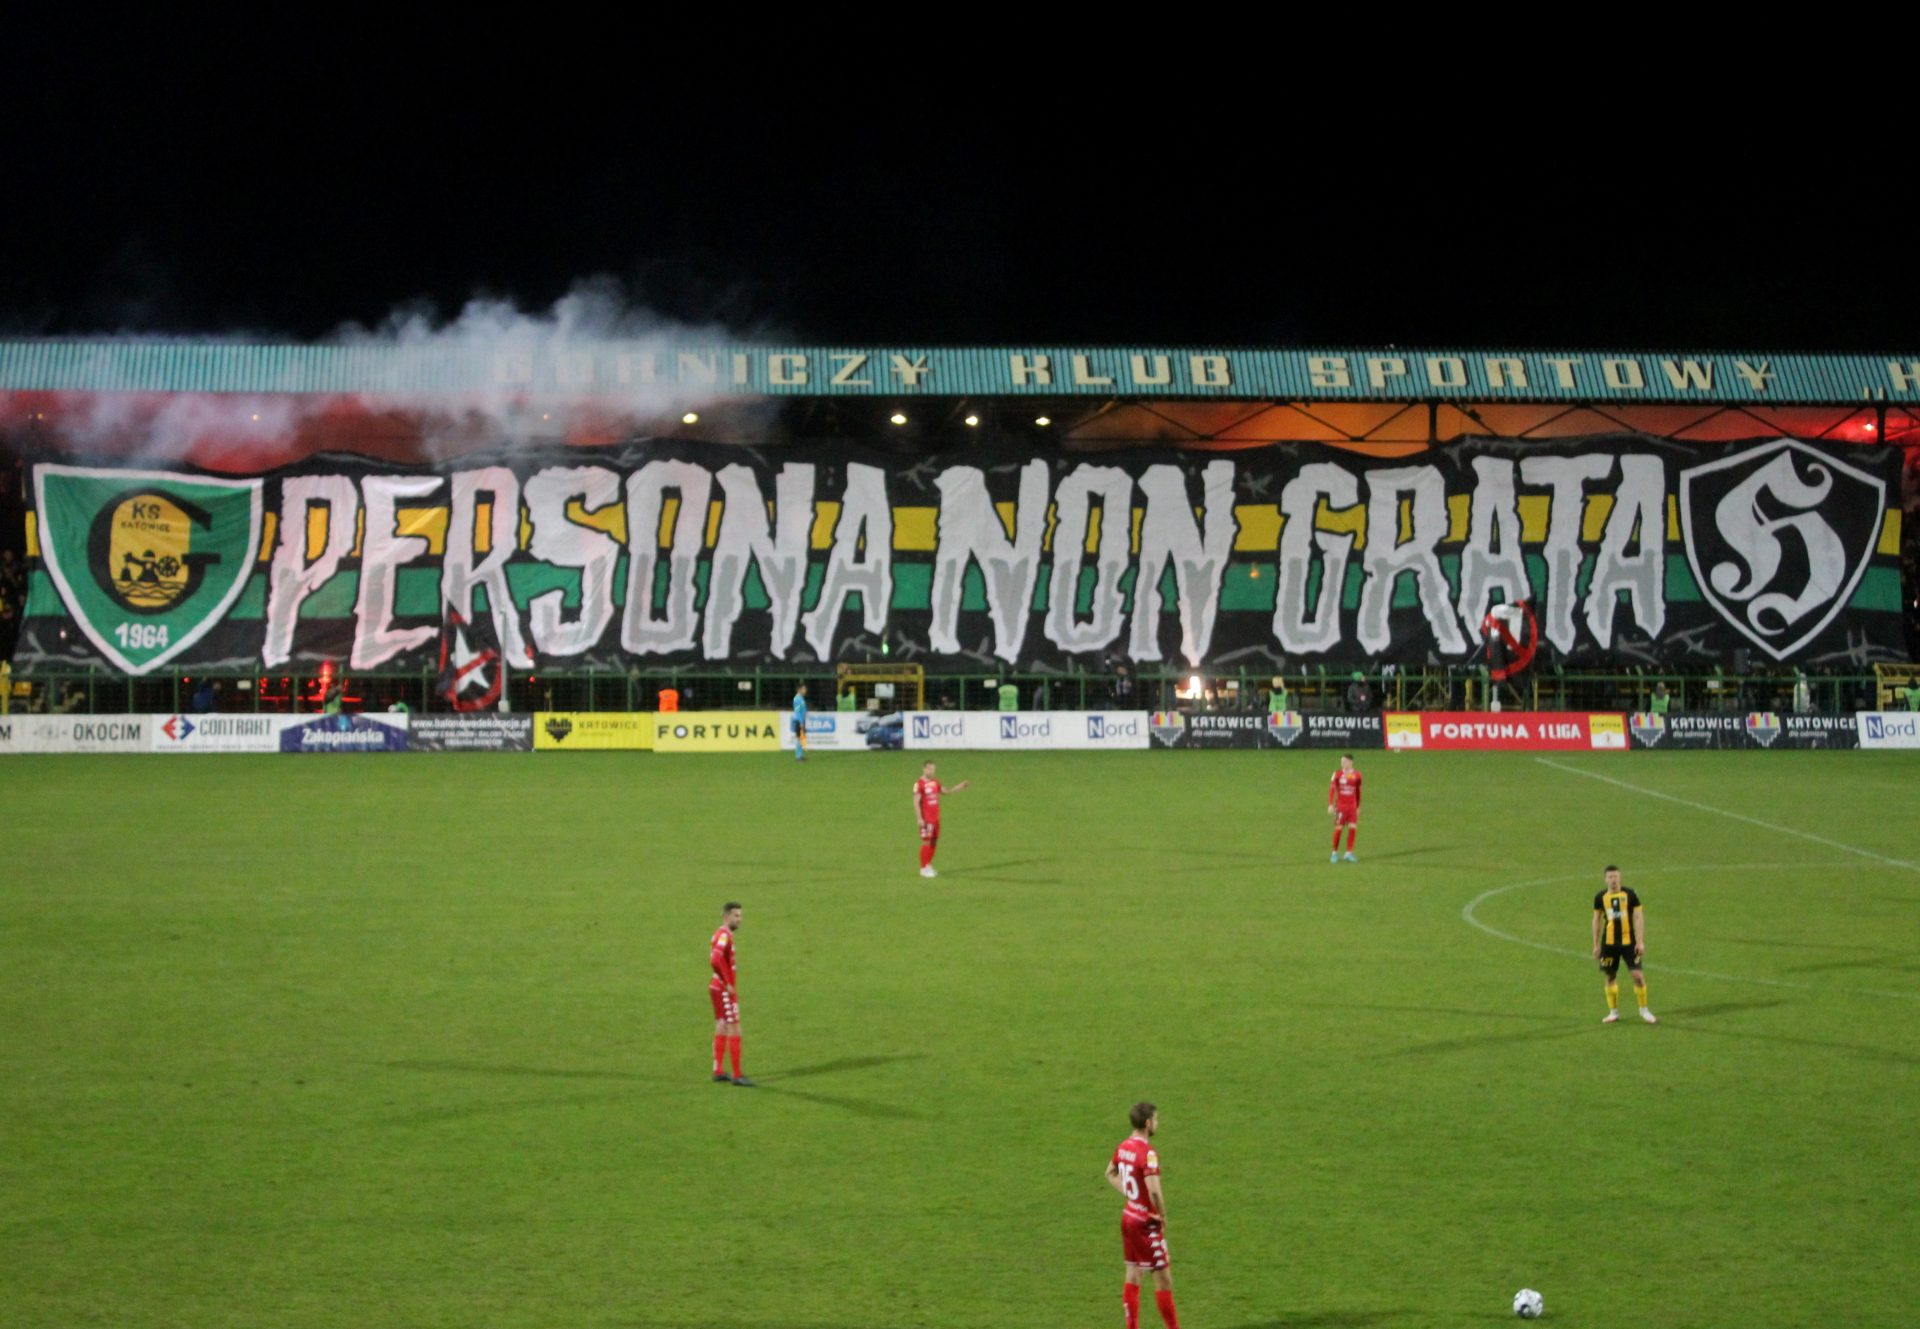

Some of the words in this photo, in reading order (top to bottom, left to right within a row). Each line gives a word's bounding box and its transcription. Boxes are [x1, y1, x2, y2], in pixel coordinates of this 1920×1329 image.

[1009, 354, 1231, 386] KLUB
[1308, 357, 1776, 391] SPORTOWY
[131, 503, 161, 520] KS
[262, 459, 893, 671] PERSONA
[930, 458, 1239, 667] NON
[1273, 453, 1666, 656] GRATA
[115, 622, 169, 649] 1964
[200, 719, 271, 736] CONTRAKT
[579, 720, 638, 729] KATOWICE
[658, 724, 775, 738] FORTUNA
[913, 716, 963, 738] Nord
[1001, 716, 1051, 738] Nord
[1088, 716, 1138, 738] Nord
[1191, 716, 1262, 729] KATOWICE
[1309, 716, 1380, 729] KATOWICE
[1671, 716, 1740, 729] KATOWICE
[1786, 716, 1855, 729] KATOWICE
[1866, 716, 1916, 738] Nord
[73, 723, 141, 740] OKOCIM
[302, 728, 385, 747] Zakopiańska
[1430, 724, 1529, 739] FORTUNA
